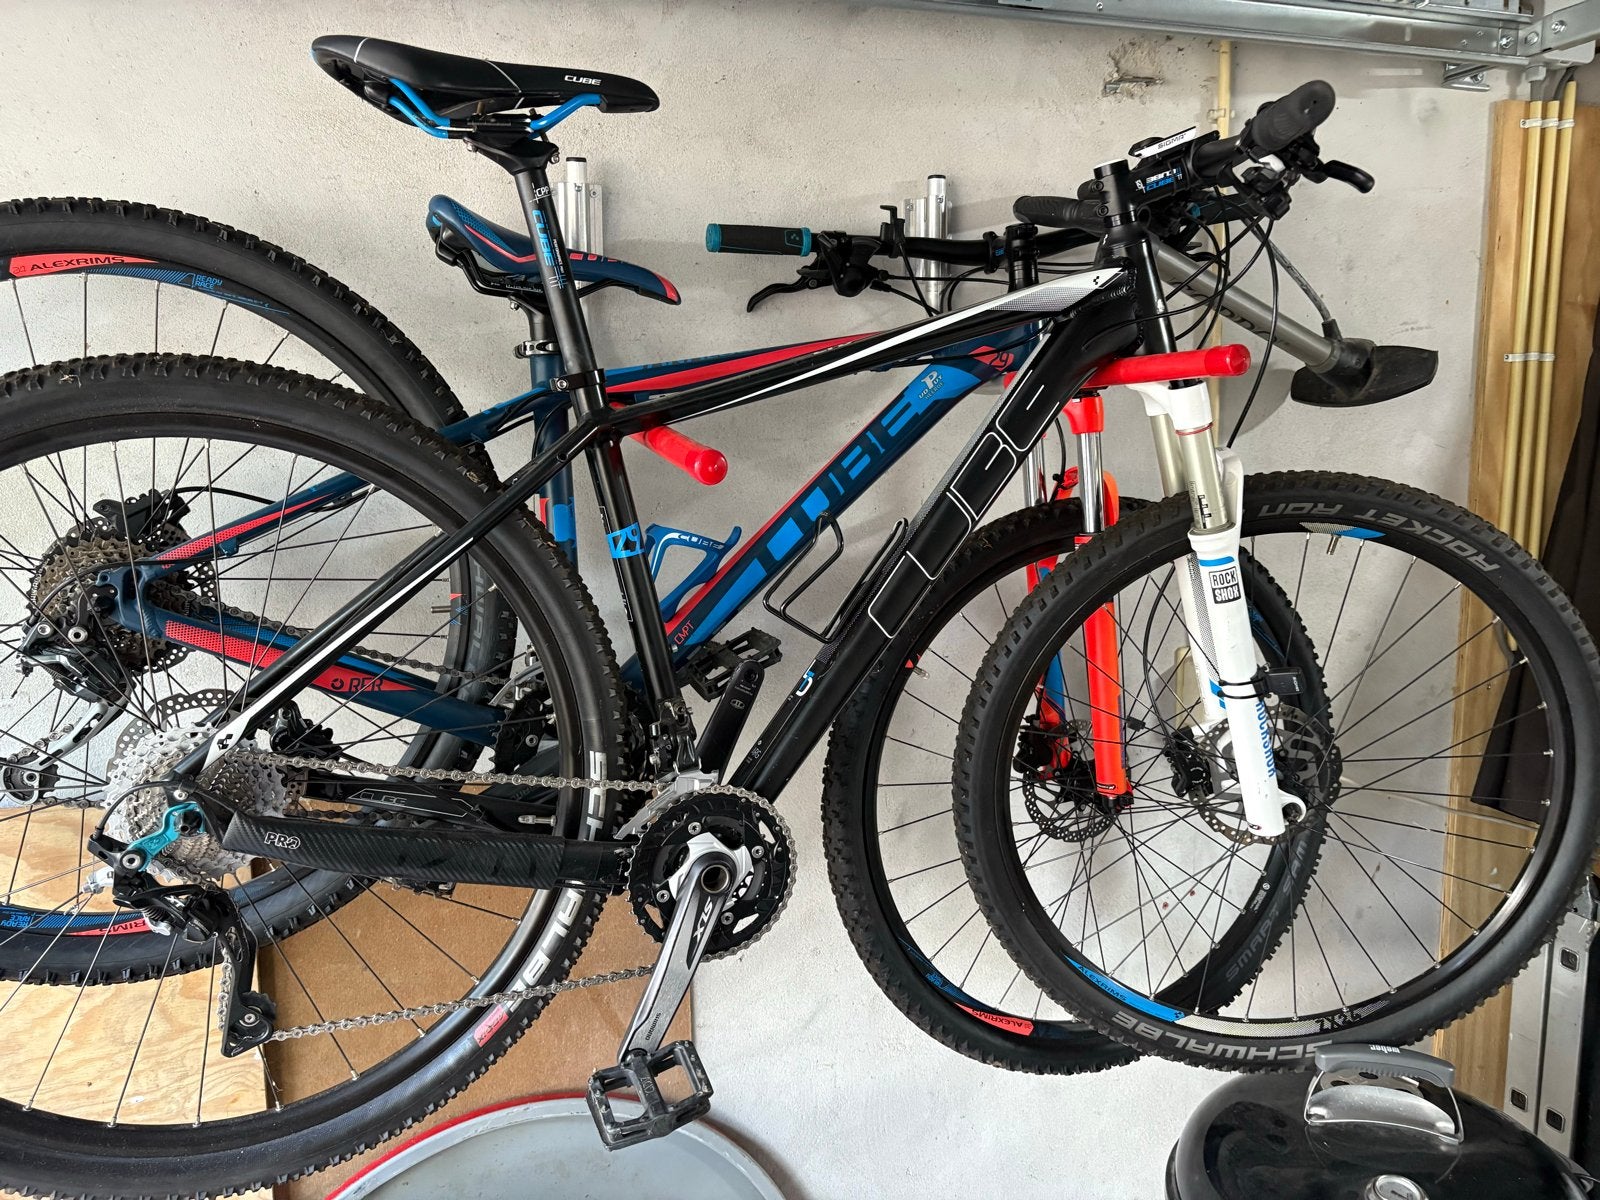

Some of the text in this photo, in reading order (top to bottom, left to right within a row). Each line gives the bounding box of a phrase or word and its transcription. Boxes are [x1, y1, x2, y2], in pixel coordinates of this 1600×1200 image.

[564, 75, 602, 86] CUBE
[1157, 133, 1186, 150] SIGMA
[532, 209, 554, 267] CUBE
[30, 256, 126, 272] ALEXRIMS
[194, 275, 223, 286] READY
[194, 281, 215, 290] RACE
[1257, 501, 1501, 573] ROCKET RON
[1212, 570, 1237, 587] ROCK
[1214, 586, 1240, 602] SHOX
[674, 620, 694, 645] CMPT
[348, 677, 384, 692] RFR
[693, 896, 713, 939] SLX
[1077, 964, 1127, 1001] ALEXRIMS
[971, 1008, 1024, 1028] ALEXRIMS
[645, 1012, 662, 1042] SHIMANO
[1111, 1010, 1332, 1061] SCHWALBE
[1369, 1044, 1400, 1054] weber
